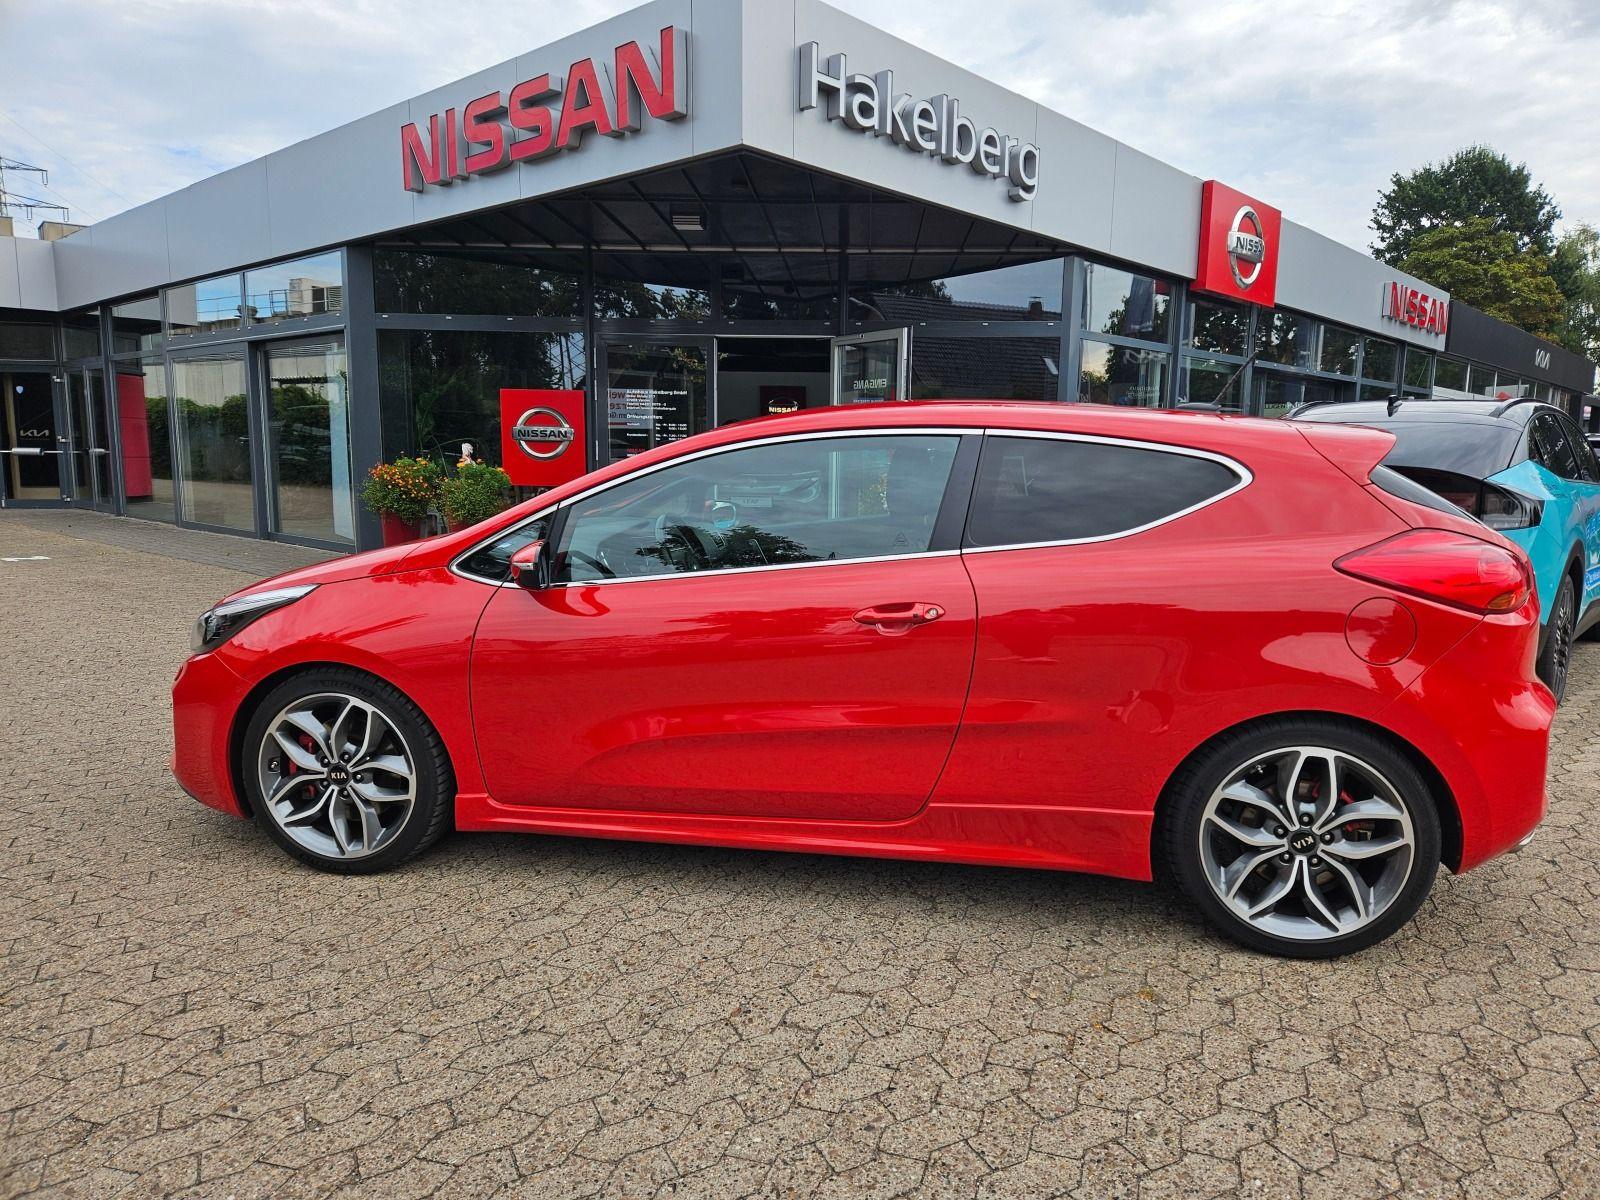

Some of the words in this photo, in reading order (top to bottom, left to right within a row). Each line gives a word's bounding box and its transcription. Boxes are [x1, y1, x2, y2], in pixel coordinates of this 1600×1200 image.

[401, 25, 687, 192] NISSAN
[799, 41, 1040, 202] Hakelberg
[1382, 281, 1449, 337] NISSAN
[20, 429, 49, 437] KIA
[517, 429, 567, 439] NISSAN
[330, 771, 347, 780] KIA
[1293, 835, 1315, 850] KIA
